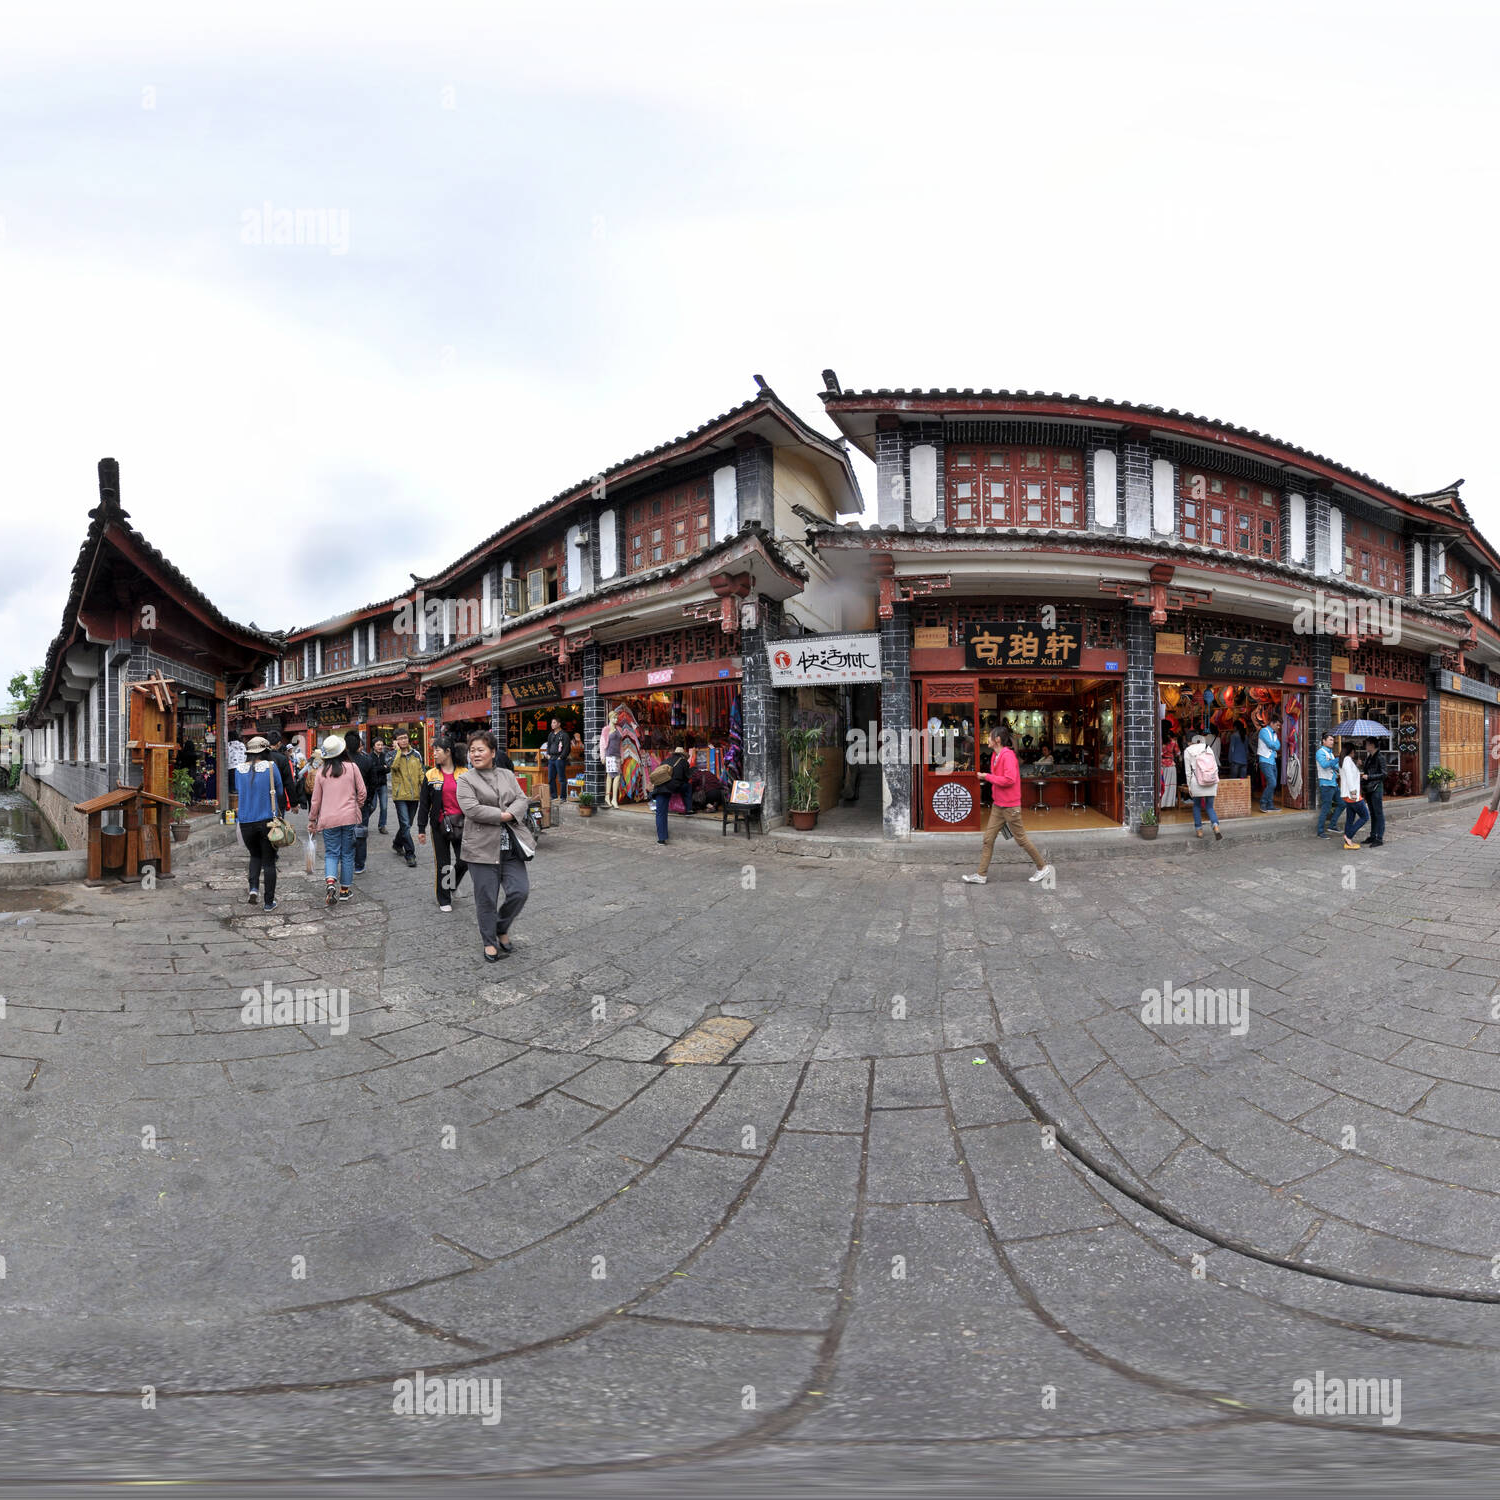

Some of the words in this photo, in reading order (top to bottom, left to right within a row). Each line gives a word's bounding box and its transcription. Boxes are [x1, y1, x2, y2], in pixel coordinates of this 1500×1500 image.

[970, 631, 1078, 660] 古珀轩
[987, 657, 1003, 666] Old
[1006, 657, 1035, 666] Amber
[1040, 657, 1063, 666] Xuan
[1248, 669, 1275, 679] STORY
